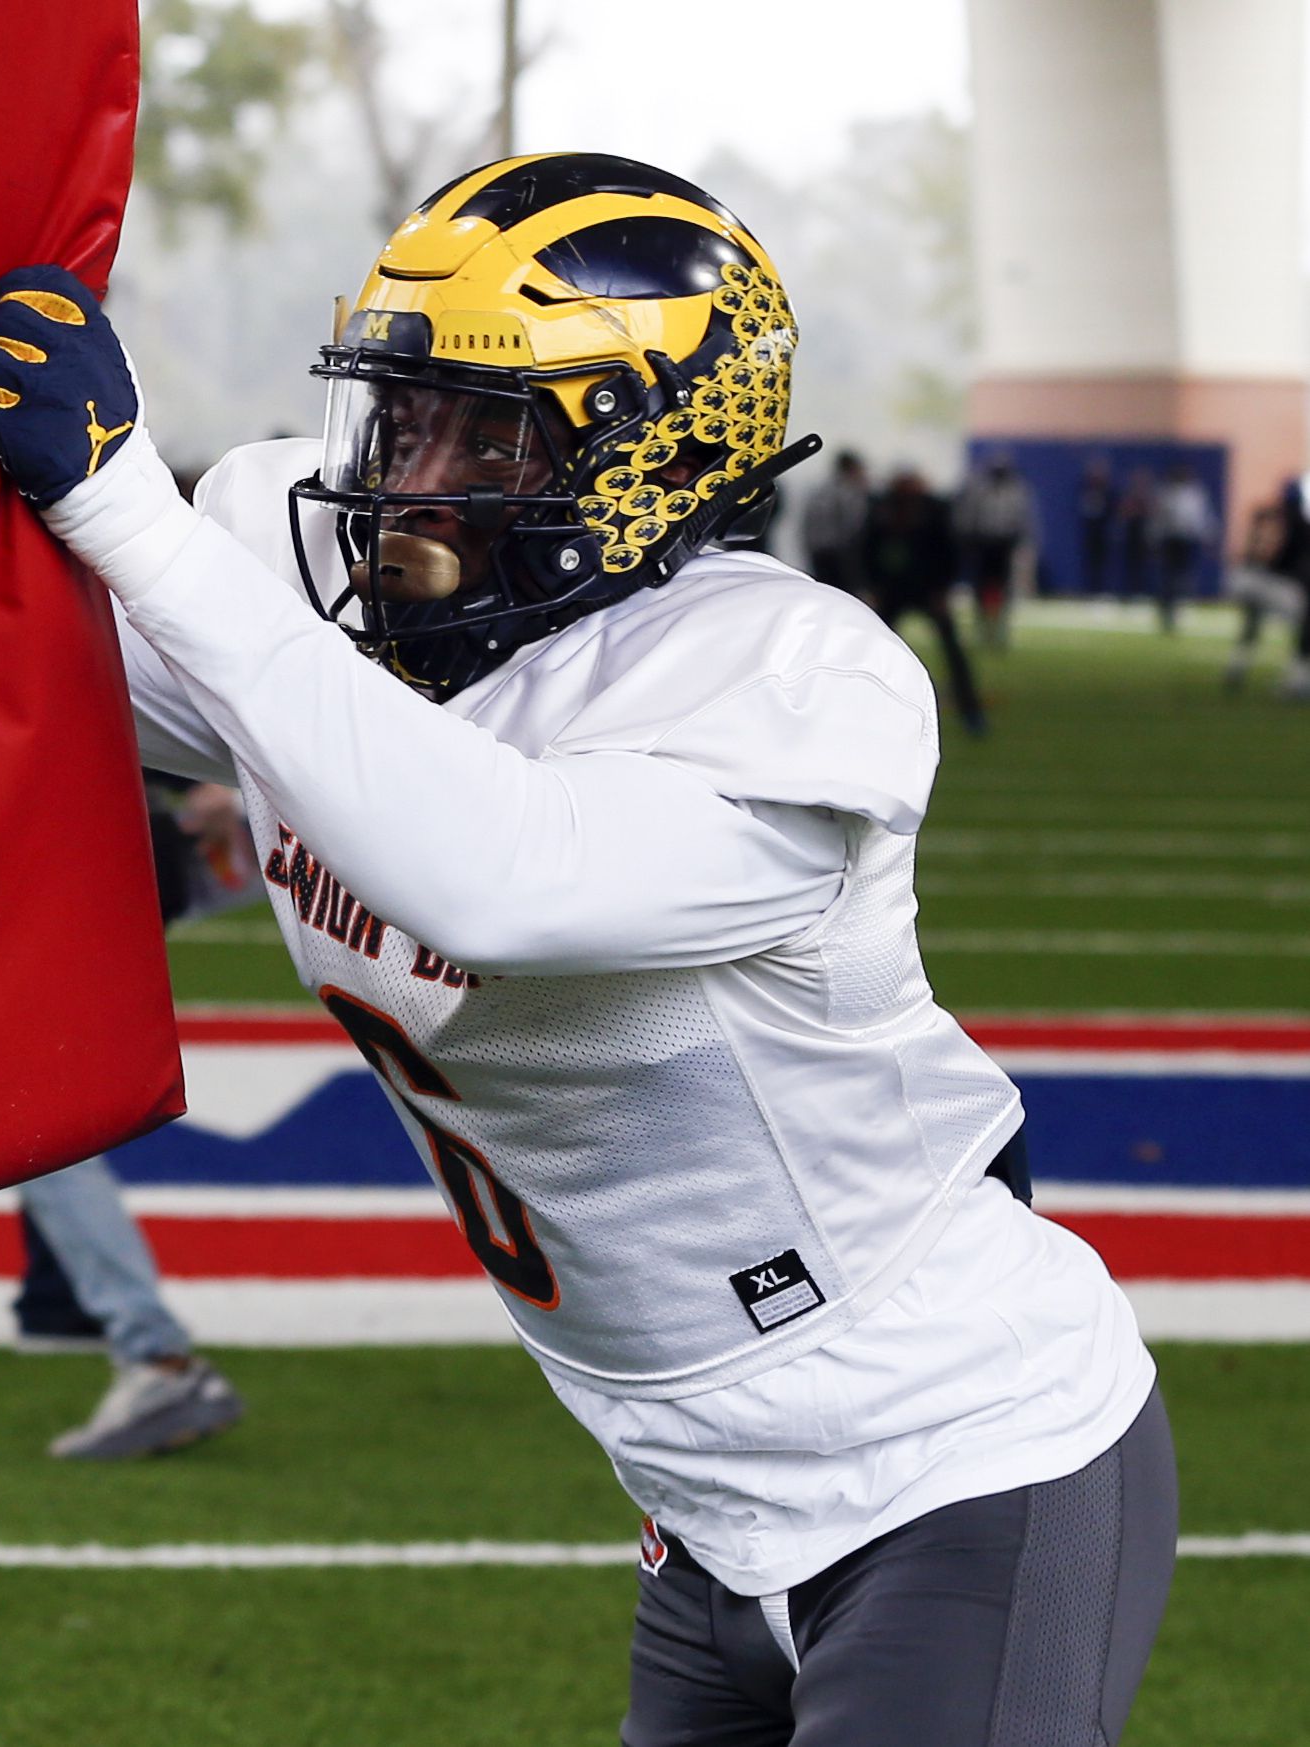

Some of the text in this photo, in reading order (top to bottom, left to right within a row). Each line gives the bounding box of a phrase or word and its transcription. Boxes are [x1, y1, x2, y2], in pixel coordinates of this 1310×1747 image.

[361, 312, 394, 341] M
[439, 334, 521, 350] JORDAN
[318, 983, 561, 1312] 6
[749, 1268, 790, 1294] XL
